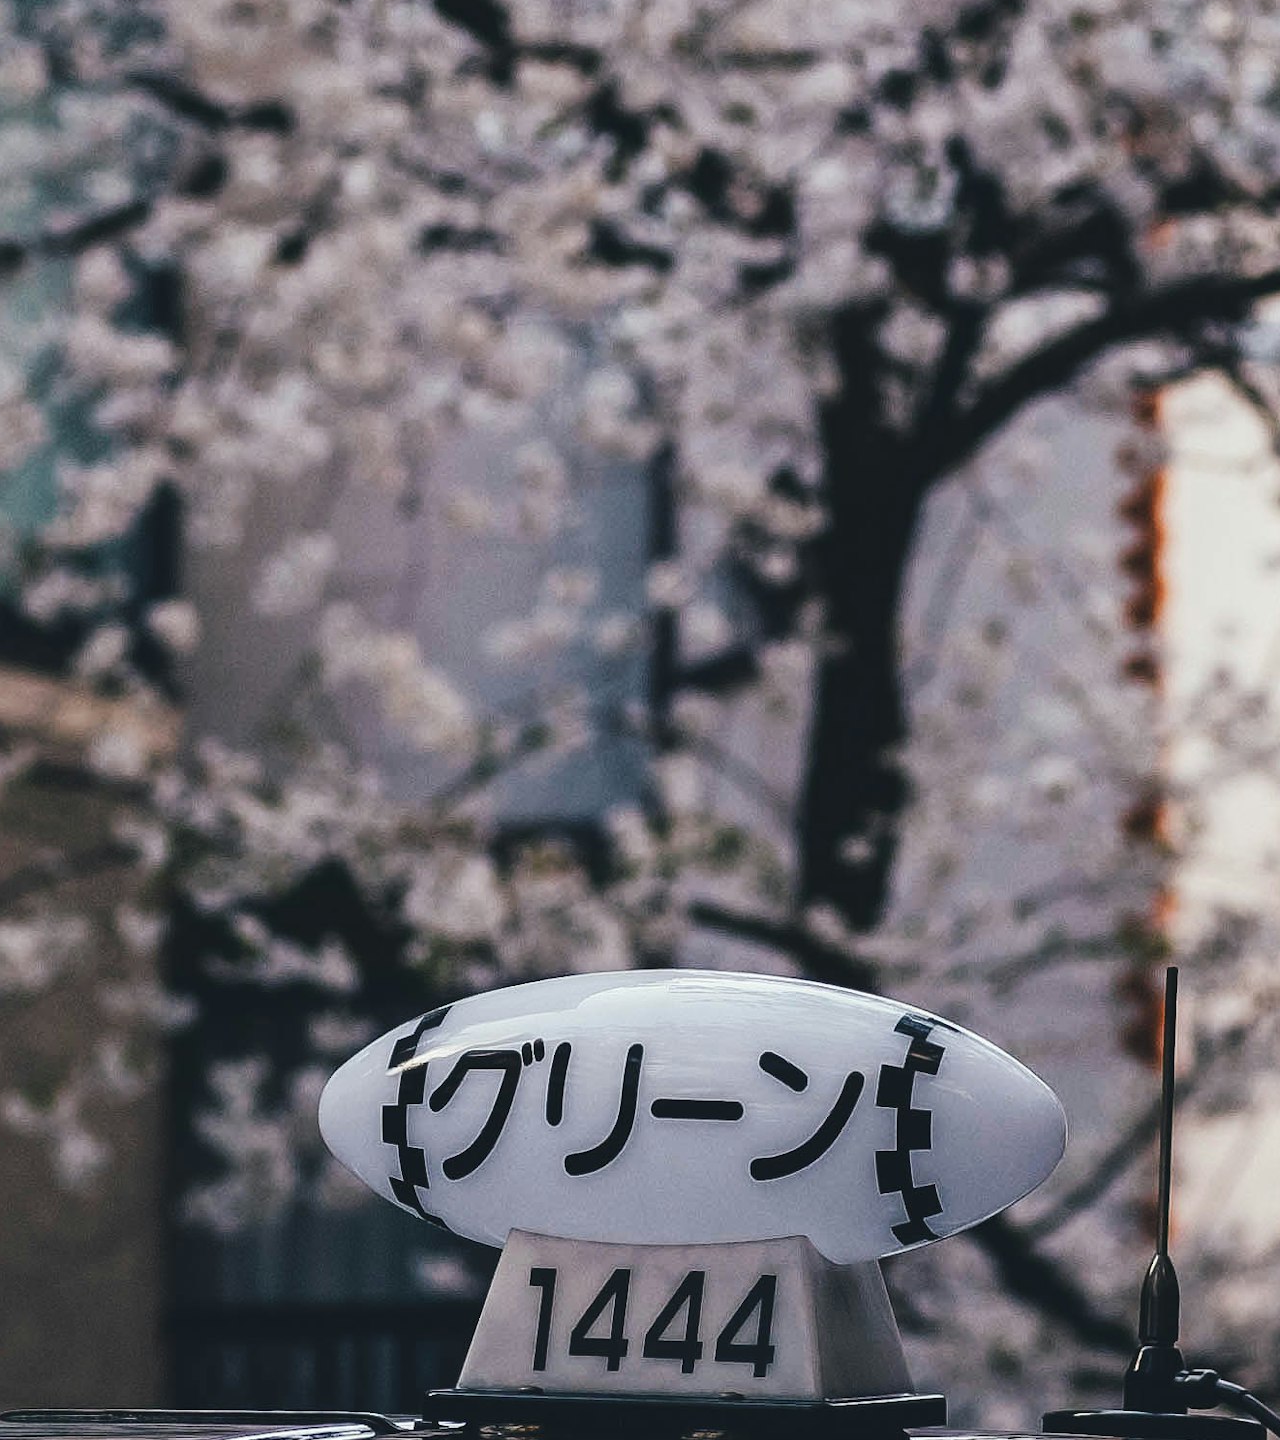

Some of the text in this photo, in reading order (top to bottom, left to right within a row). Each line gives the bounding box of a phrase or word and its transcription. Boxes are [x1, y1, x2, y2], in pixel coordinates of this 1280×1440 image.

[429, 1039, 865, 1182] グリーン
[528, 1266, 779, 1379] 1444
